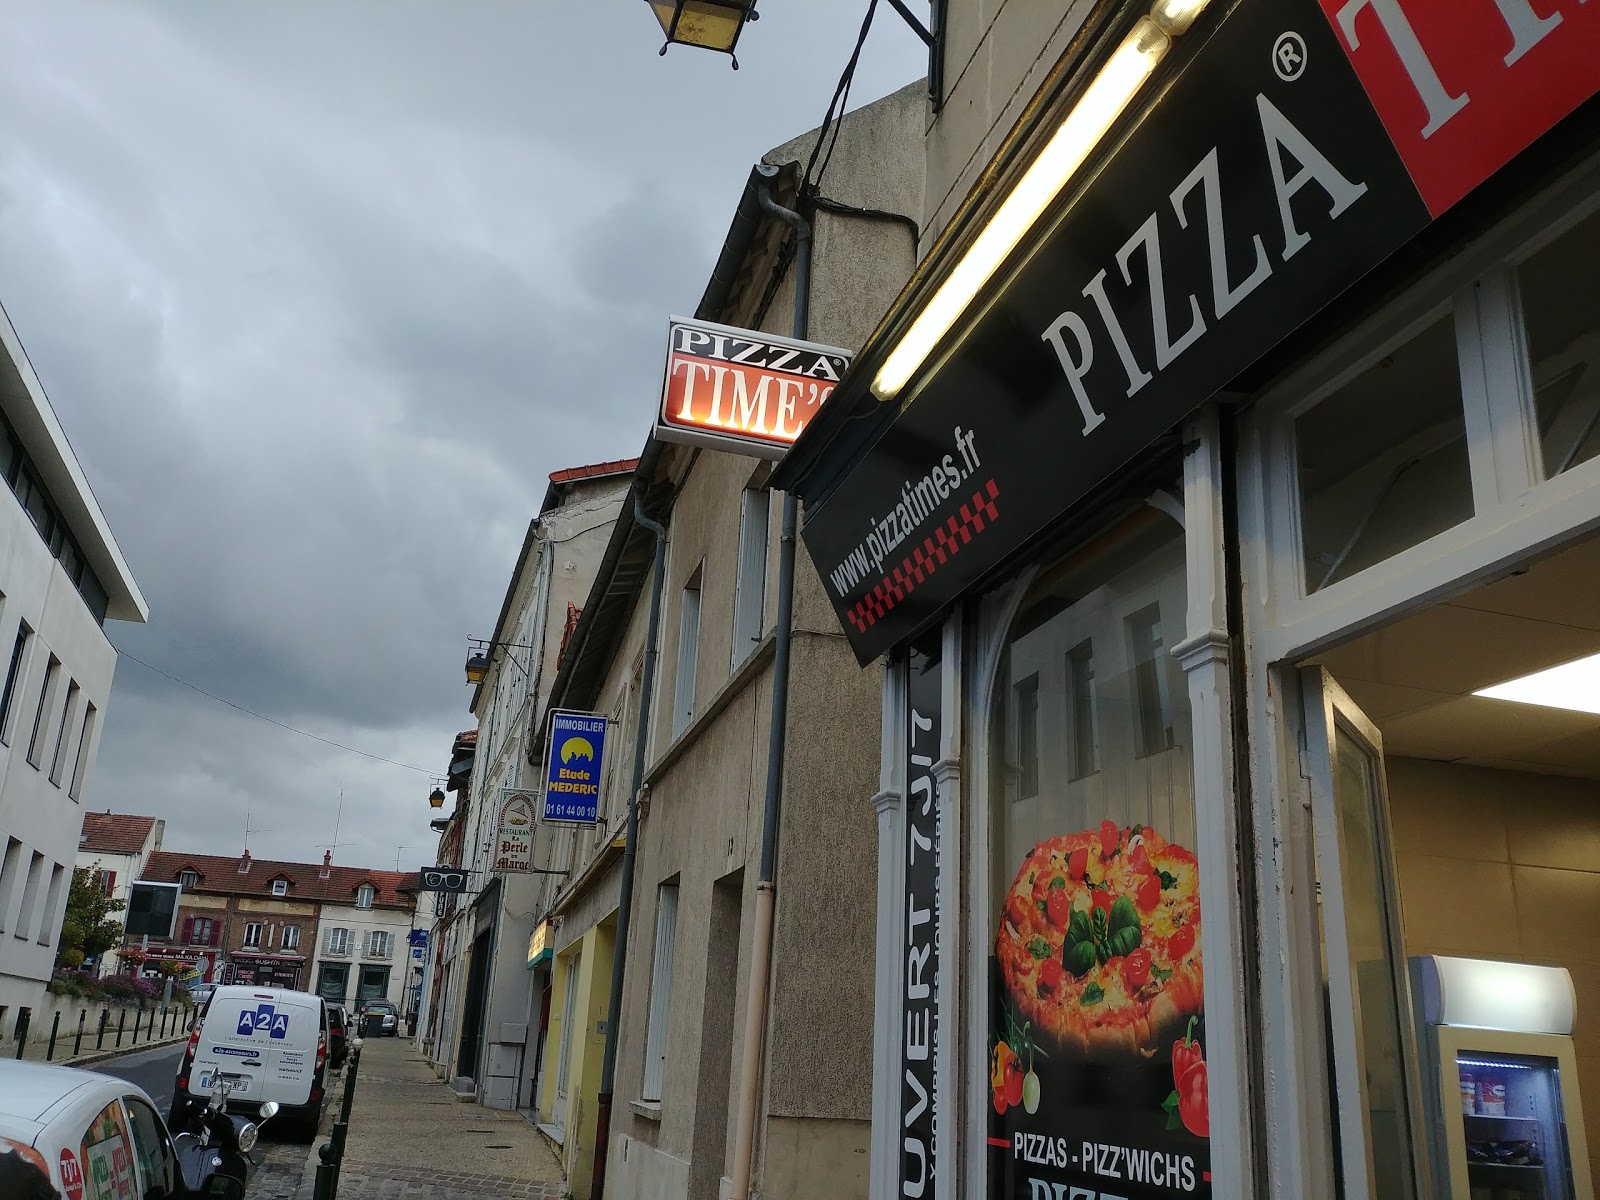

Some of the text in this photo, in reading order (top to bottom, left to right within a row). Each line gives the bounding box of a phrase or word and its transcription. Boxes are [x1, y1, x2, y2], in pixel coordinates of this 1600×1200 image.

[829, 425, 982, 598] www.pizzatimes.fr
[555, 718, 604, 733] IMMOBILIER
[559, 767, 590, 781] Etude
[549, 781, 598, 795] MEDERIC
[546, 804, 596, 818] 01 61 44 00 10
[499, 828, 533, 837] RESTAURANT
[500, 840, 529, 855] Perle
[495, 857, 530, 870] Maroc
[239, 1012, 286, 1031] A2A
[1014, 1131, 1068, 1169] PIZZAS
[1082, 1141, 1196, 1192] PIZZ'WICHS
